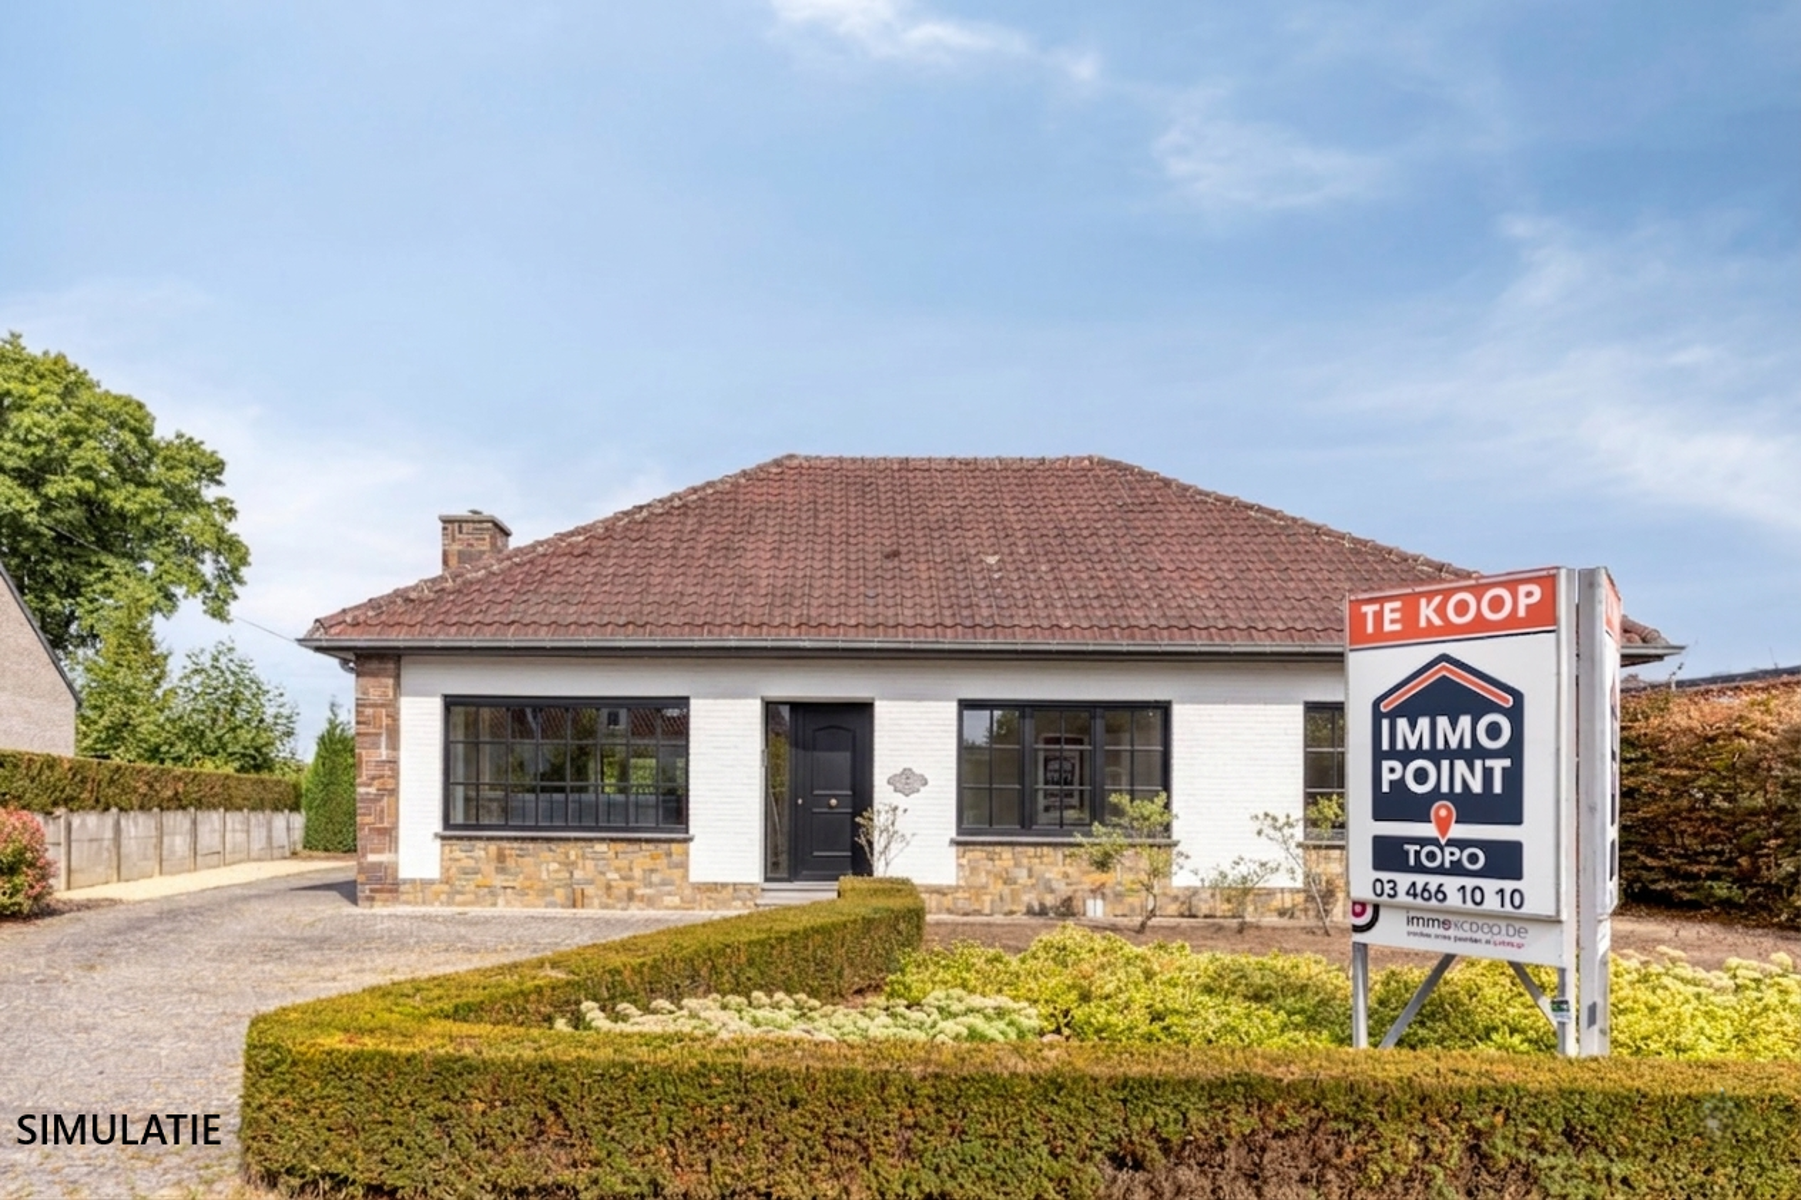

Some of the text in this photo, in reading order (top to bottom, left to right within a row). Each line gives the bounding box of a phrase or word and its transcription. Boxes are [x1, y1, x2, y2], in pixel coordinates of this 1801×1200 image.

[1361, 584, 1542, 634] TE KOOP
[1381, 713, 1512, 751] IMMO
[1381, 758, 1511, 794] POINT
[1403, 844, 1486, 871] TOPO
[1372, 878, 1525, 910] 03 466 10 10
